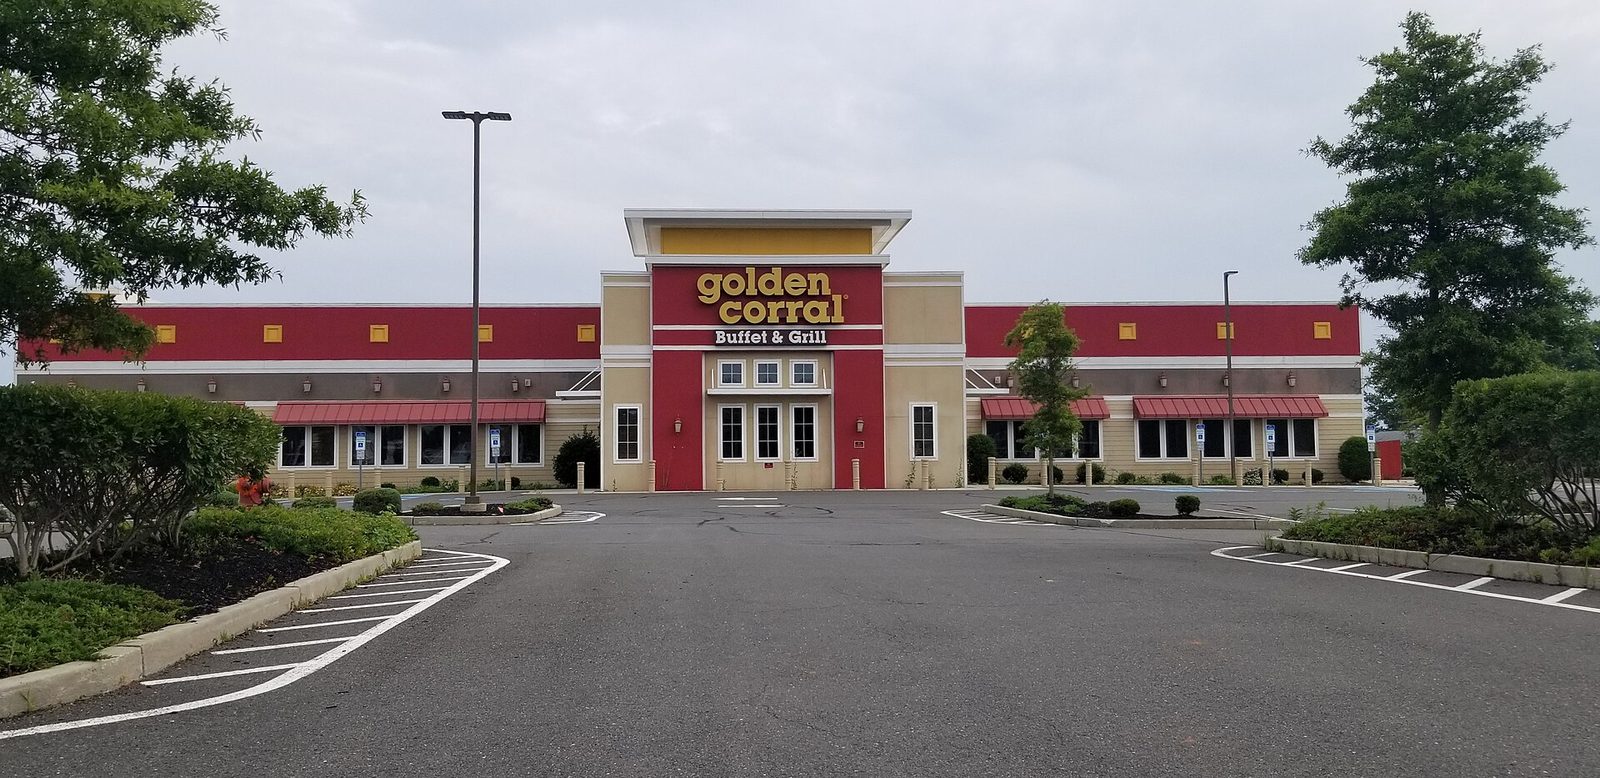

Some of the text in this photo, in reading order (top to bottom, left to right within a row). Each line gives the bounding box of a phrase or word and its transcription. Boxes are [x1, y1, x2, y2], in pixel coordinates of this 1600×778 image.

[696, 267, 832, 304] golden
[719, 294, 845, 324] corral
[715, 331, 827, 344] Buffet & Grill
